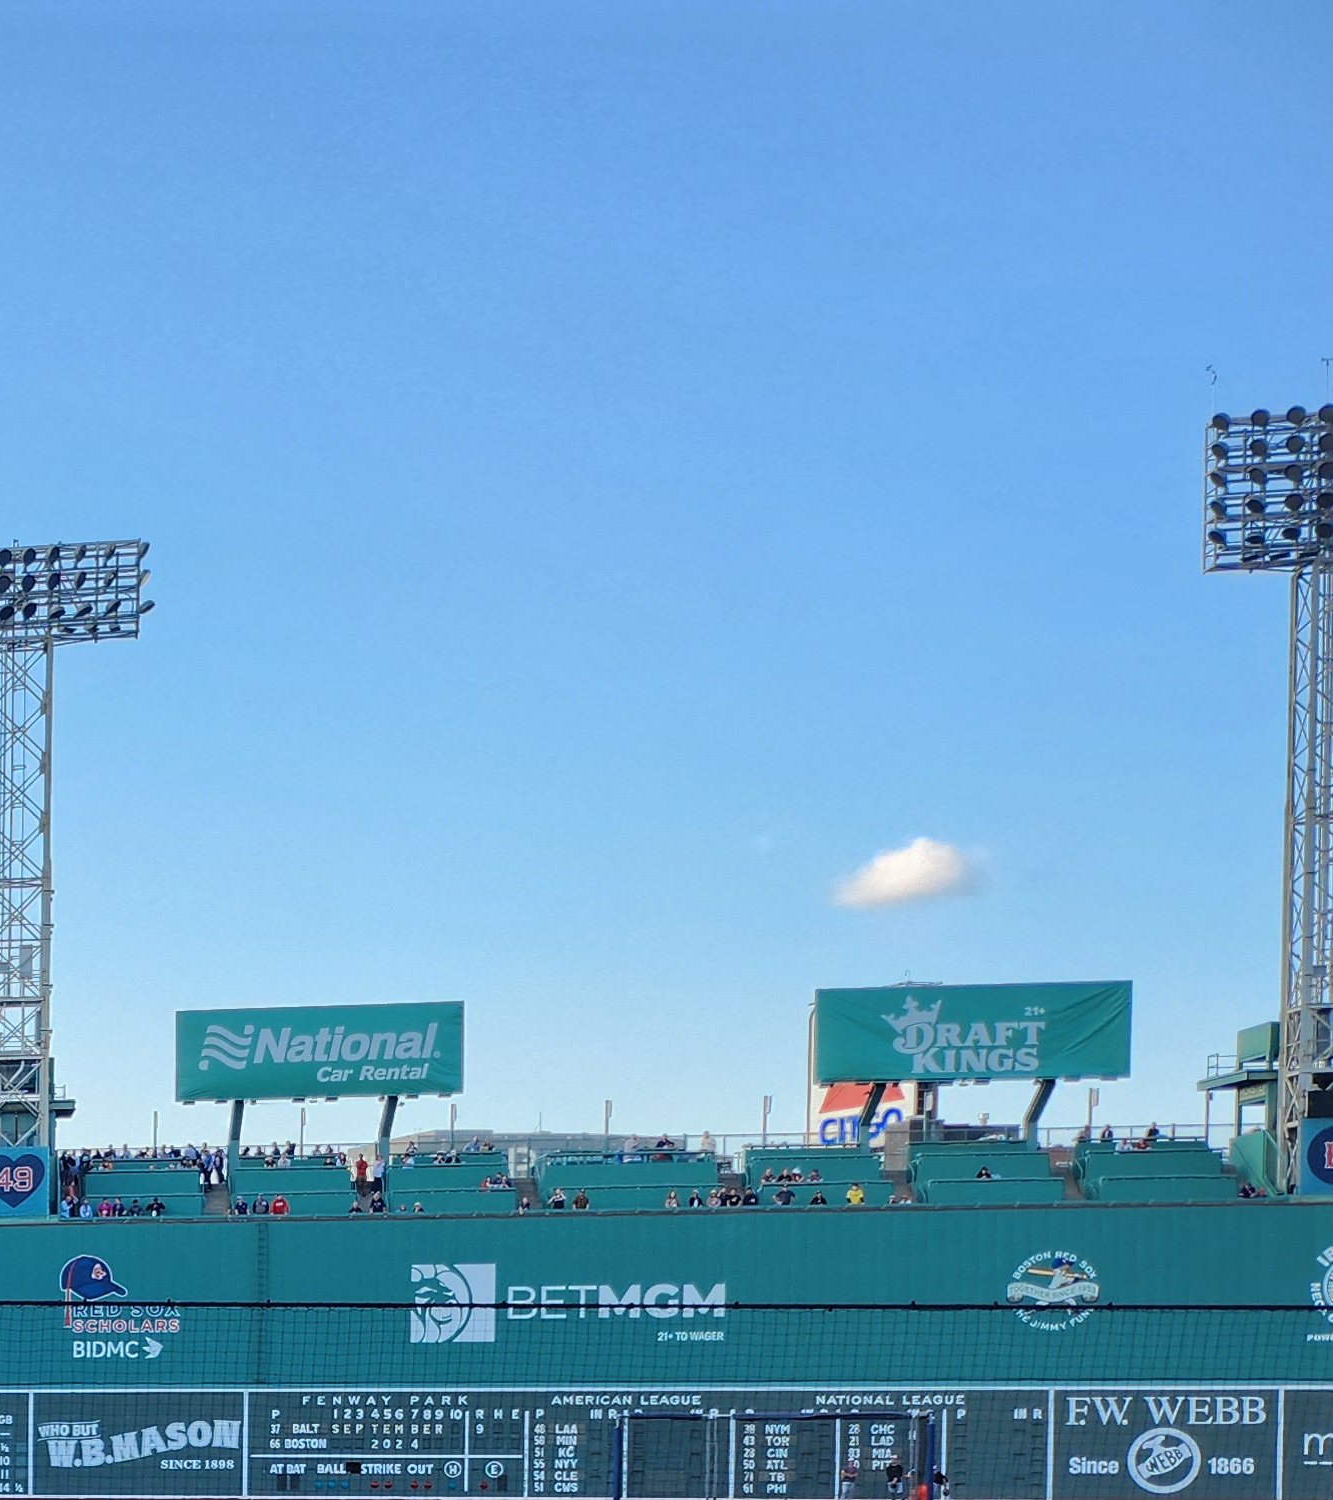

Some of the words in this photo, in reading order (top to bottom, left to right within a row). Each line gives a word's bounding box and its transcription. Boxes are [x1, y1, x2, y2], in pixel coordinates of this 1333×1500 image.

[253, 1022, 438, 1064] National
[893, 1021, 1046, 1055] DRAFT
[911, 1048, 1040, 1074] KINGS
[316, 1066, 354, 1083] Car
[359, 1064, 430, 1082] Rental
[1012, 1251, 1051, 1280] BOSTON
[1054, 1250, 1077, 1262] RED
[1078, 1260, 1098, 1279] SOX
[507, 1284, 726, 1320] BETMGM
[72, 1319, 181, 1333] SCHOLARS
[1030, 1320, 1068, 1331] JIMMY
[657, 1332, 673, 1341] 21+
[675, 1332, 689, 1341] TO
[689, 1332, 725, 1341] WAGER
[73, 1341, 139, 1359] BIDMC
[302, 1395, 392, 1406] FENWAY
[409, 1395, 469, 1406] PARK
[551, 1395, 632, 1406] AMERICAN
[640, 1395, 702, 1406] LEAGUE
[815, 1395, 895, 1406] NATIONAL
[902, 1394, 966, 1405] LEAGUE
[1065, 1396, 1133, 1426] F.W.
[1143, 1396, 1267, 1426] WEBB
[37, 1424, 71, 1437] WHO
[72, 1423, 100, 1437] BUT
[292, 1423, 320, 1434] BALT
[555, 1423, 578, 1434] LAA
[765, 1424, 790, 1434] NYM
[870, 1424, 895, 1434] CHC
[284, 1438, 327, 1449] BOSTON
[556, 1436, 578, 1446] MIN
[766, 1436, 790, 1446] TOR
[871, 1436, 894, 1446] LAD
[767, 1448, 788, 1458] CIN
[872, 1448, 892, 1459] MIA
[160, 1459, 202, 1470] SINCE
[204, 1459, 235, 1470] 1898
[554, 1459, 579, 1469] NYY
[766, 1459, 789, 1470] ATL
[1068, 1457, 1120, 1475] Since
[1207, 1458, 1255, 1475] 1866
[1146, 1448, 1184, 1475] WEBB
[286, 1463, 307, 1474] BAT
[316, 1463, 346, 1474] BALL
[360, 1463, 402, 1474] STRIKE
[407, 1463, 434, 1474] OUT
[554, 1471, 579, 1481] CLE
[554, 1482, 578, 1492] CWS
[767, 1483, 787, 1493] PHI
